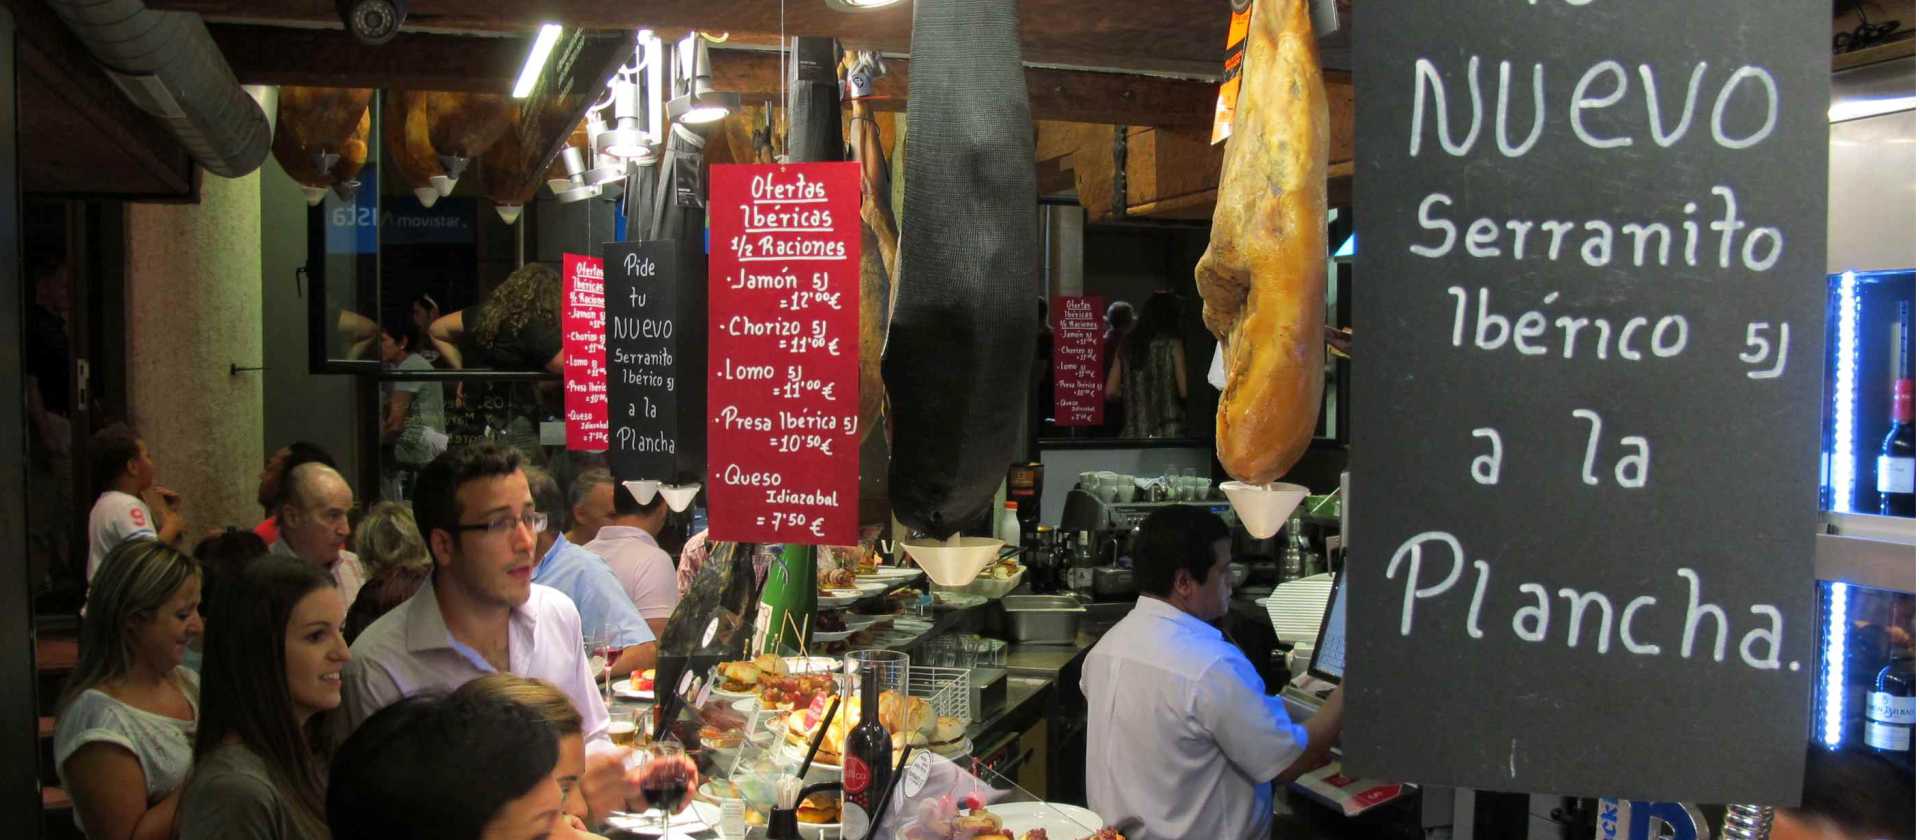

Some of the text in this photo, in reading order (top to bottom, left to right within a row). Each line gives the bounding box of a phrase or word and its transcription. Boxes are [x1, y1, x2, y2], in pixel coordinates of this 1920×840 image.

[751, 172, 826, 200] Ofertas
[739, 204, 833, 228] Ibéricas
[1409, 185, 1784, 272] Serranito
[730, 234, 846, 257] 1/2 Raciones
[623, 252, 656, 277] Pide
[731, 266, 797, 289] Jamón
[629, 286, 647, 308] tu
[729, 316, 801, 336] Chorizo
[1447, 285, 1689, 361] Ibérico
[613, 347, 674, 366] Serranito
[622, 368, 663, 388] Ibérico
[725, 358, 775, 380] Lomo
[628, 396, 657, 418] a la
[721, 405, 773, 431] Presa
[779, 407, 837, 430] Ibérica
[616, 426, 676, 455] Plancha
[1470, 407, 1651, 488] a la
[724, 463, 782, 486] Queso
[765, 489, 839, 507] Idiazabal
[129, 506, 146, 528] 9
